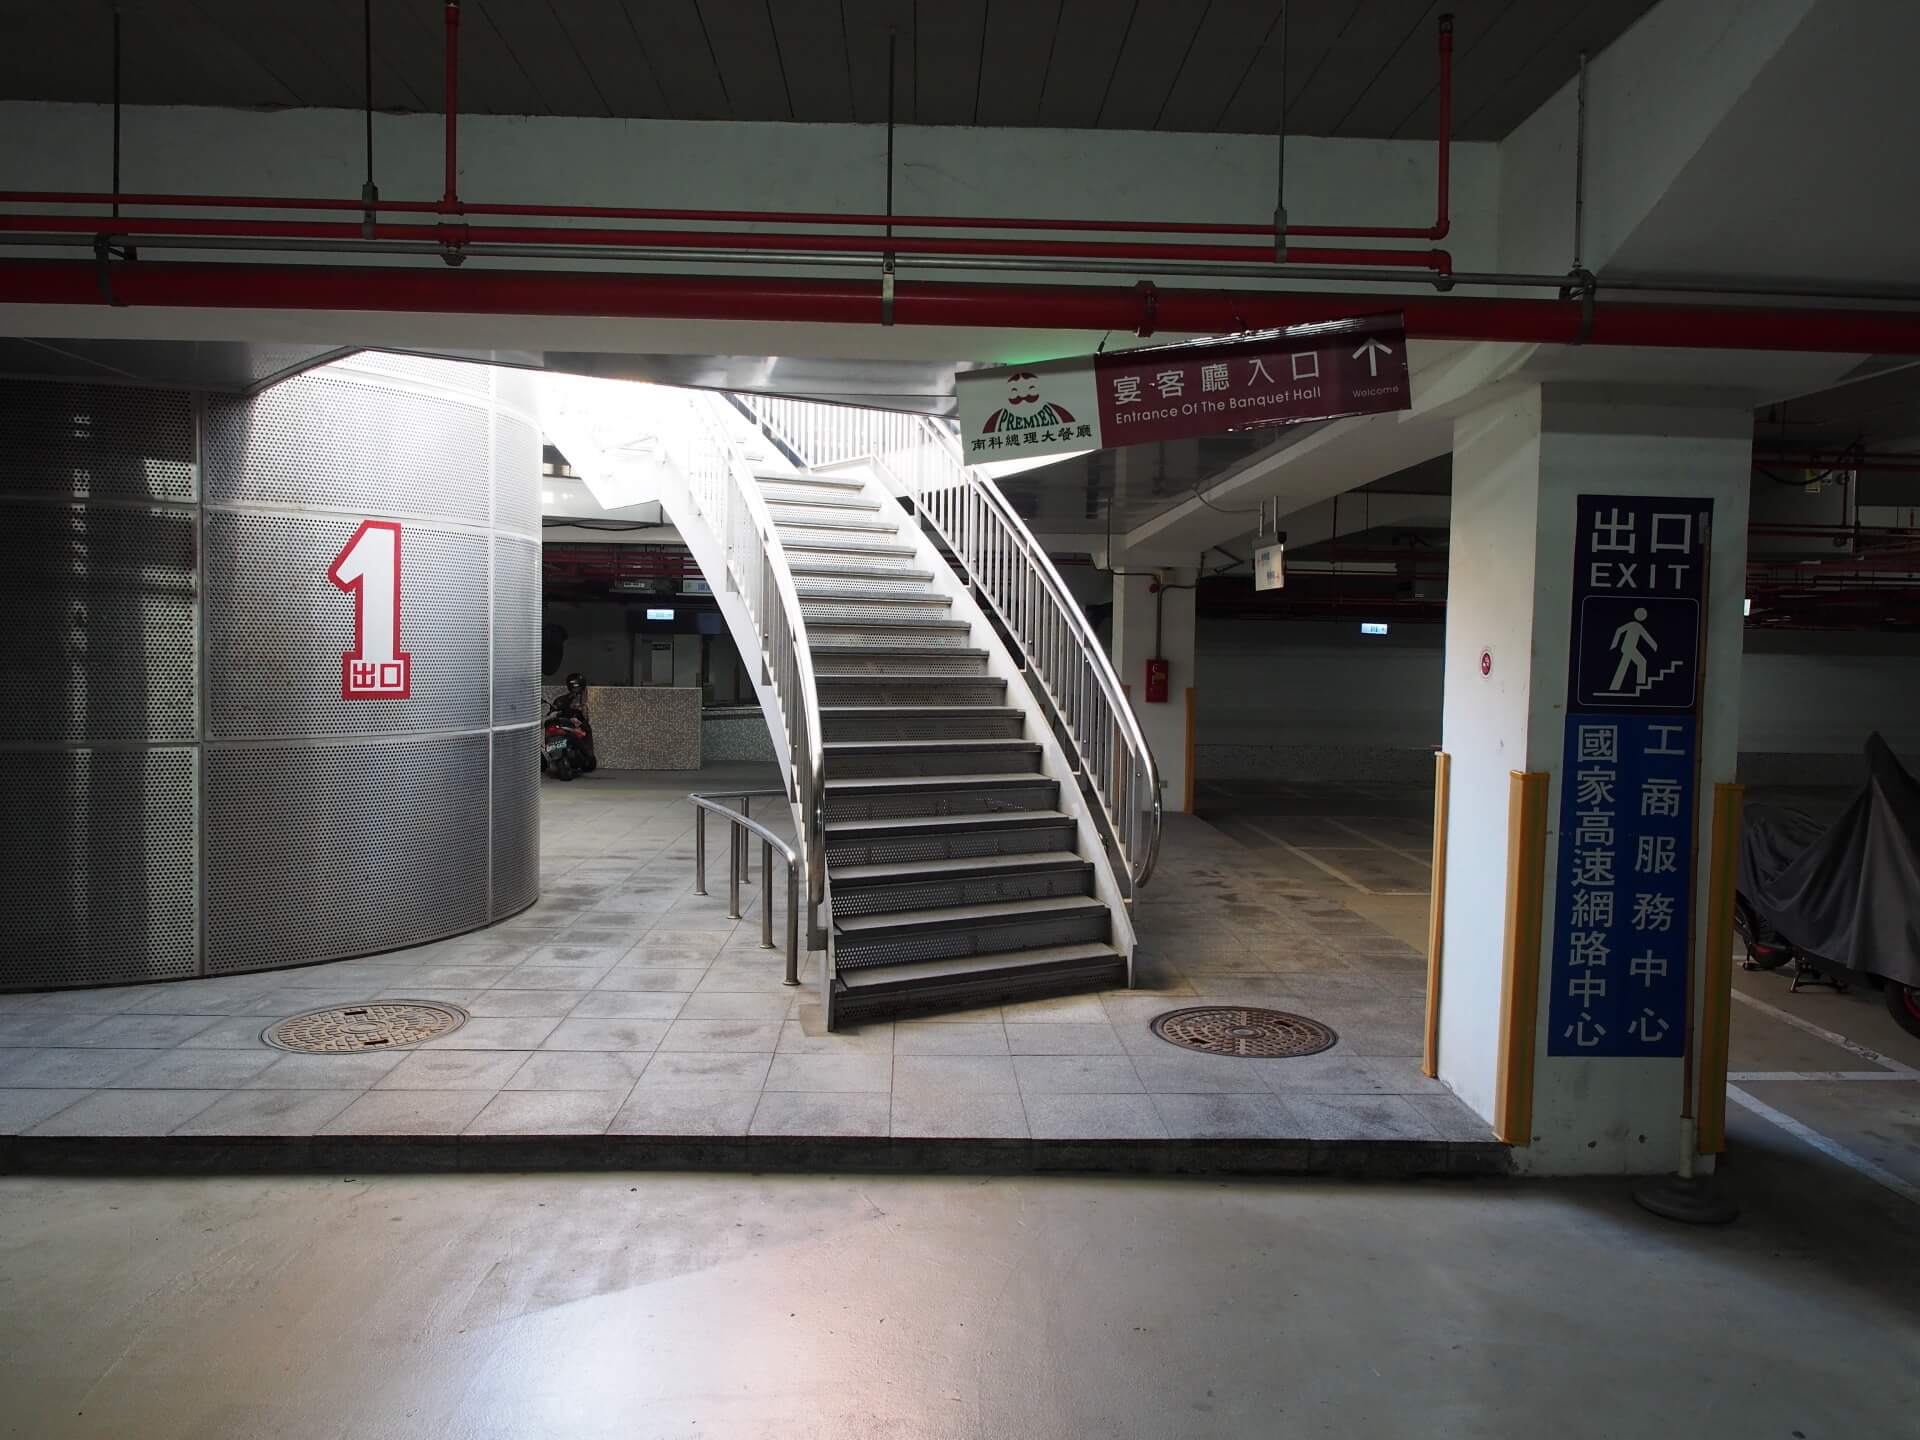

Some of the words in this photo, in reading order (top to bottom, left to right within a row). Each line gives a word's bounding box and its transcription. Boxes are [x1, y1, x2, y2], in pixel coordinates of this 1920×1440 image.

[1113, 351, 1320, 405] 宴客廳入口
[1352, 384, 1400, 398] Welcome
[997, 404, 1060, 432] PREMIER
[1115, 407, 1179, 425] Entrance
[1181, 401, 1198, 415] Of
[1201, 399, 1226, 413] The
[1229, 390, 1289, 409] Banquet
[1293, 385, 1321, 401] Hall
[970, 424, 1092, 452] 南科總理大餐廳
[1591, 508, 1692, 554] 出口
[335, 527, 395, 661] 1
[1590, 562, 1690, 590] EXIT
[352, 662, 401, 688] 出口
[1564, 724, 1619, 1048] 國家高速網路中心
[1627, 724, 1686, 1043] 工商服務中心
